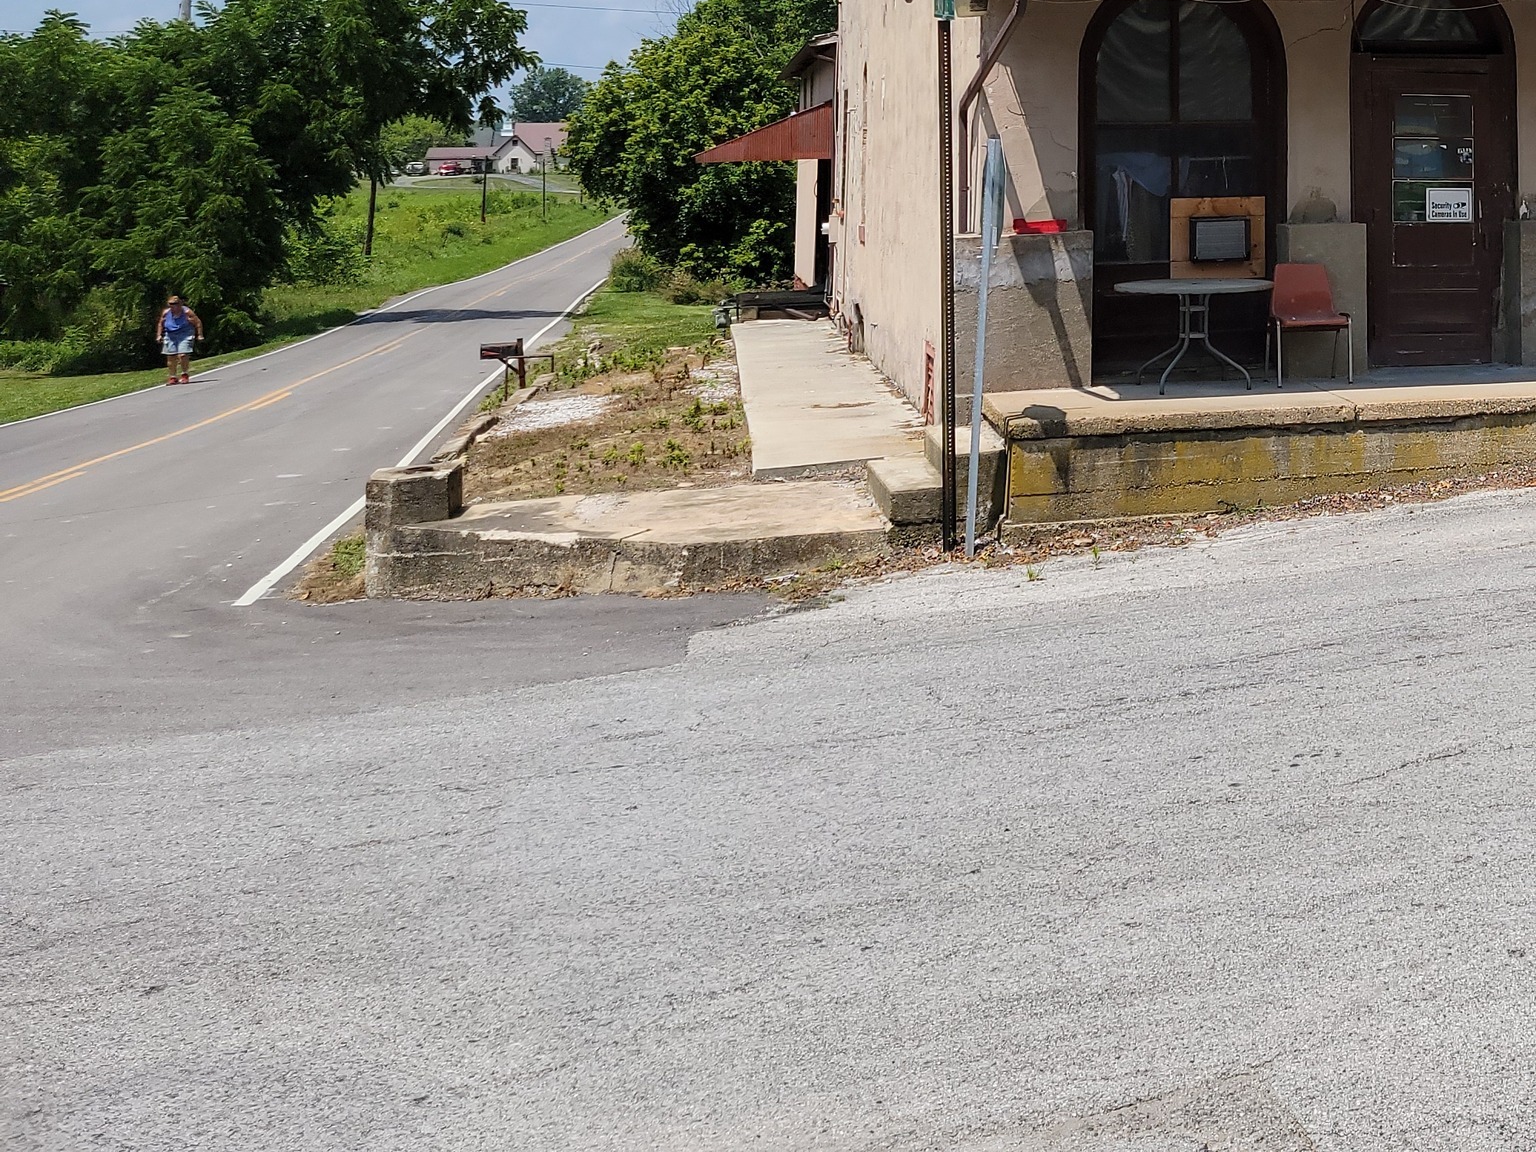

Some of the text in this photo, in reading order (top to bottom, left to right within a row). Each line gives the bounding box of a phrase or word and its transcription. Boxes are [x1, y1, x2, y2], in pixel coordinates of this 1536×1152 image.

[1431, 201, 1452, 210] Security
[1431, 210, 1452, 218] Cameras
[1459, 210, 1467, 218] Use
